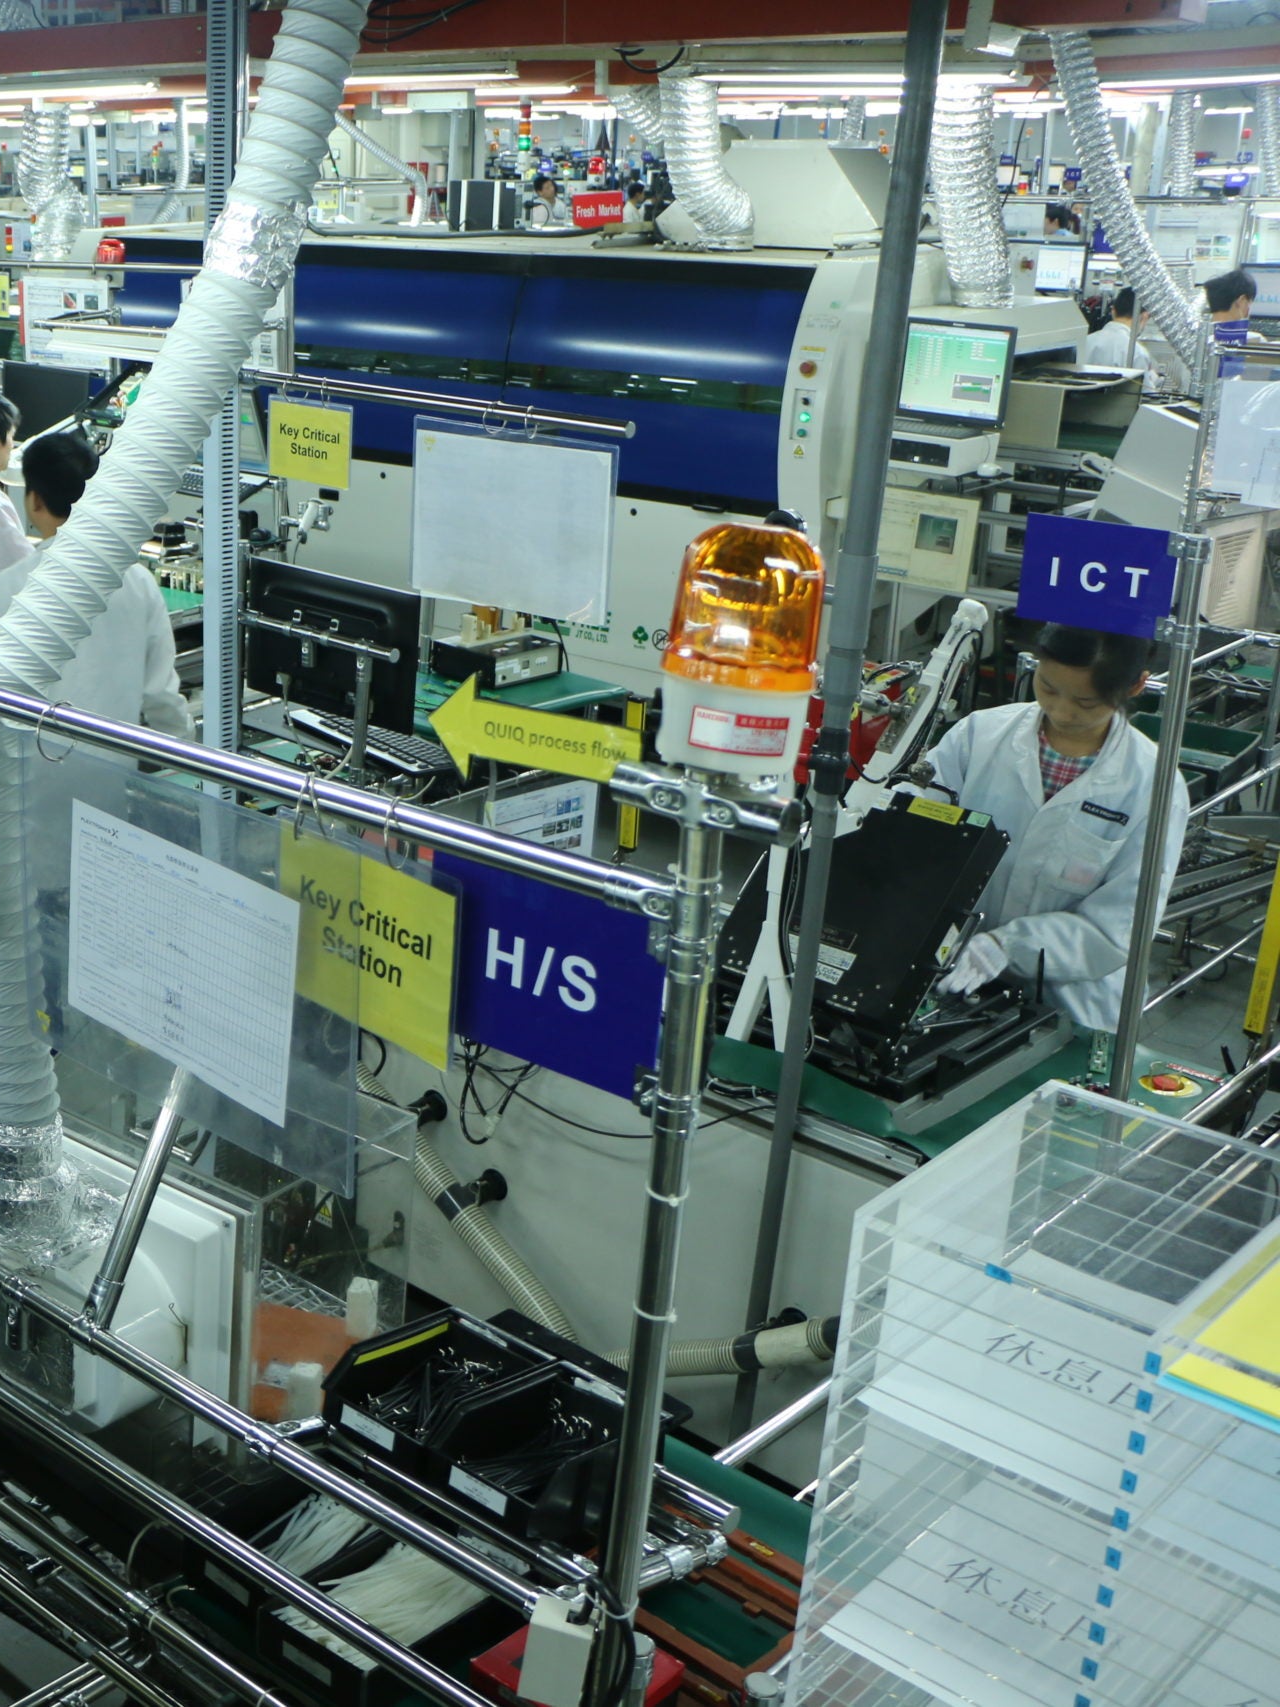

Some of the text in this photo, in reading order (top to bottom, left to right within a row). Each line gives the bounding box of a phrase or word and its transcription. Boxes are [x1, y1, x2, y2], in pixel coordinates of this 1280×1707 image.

[576, 203, 622, 218] Fresh Market
[279, 422, 340, 444] Key Critical
[290, 442, 328, 460] Station
[484, 720, 627, 761] QUIQ process flow
[299, 874, 433, 960] Key Critical
[322, 926, 403, 987] Station
[485, 926, 598, 1012] H/S
